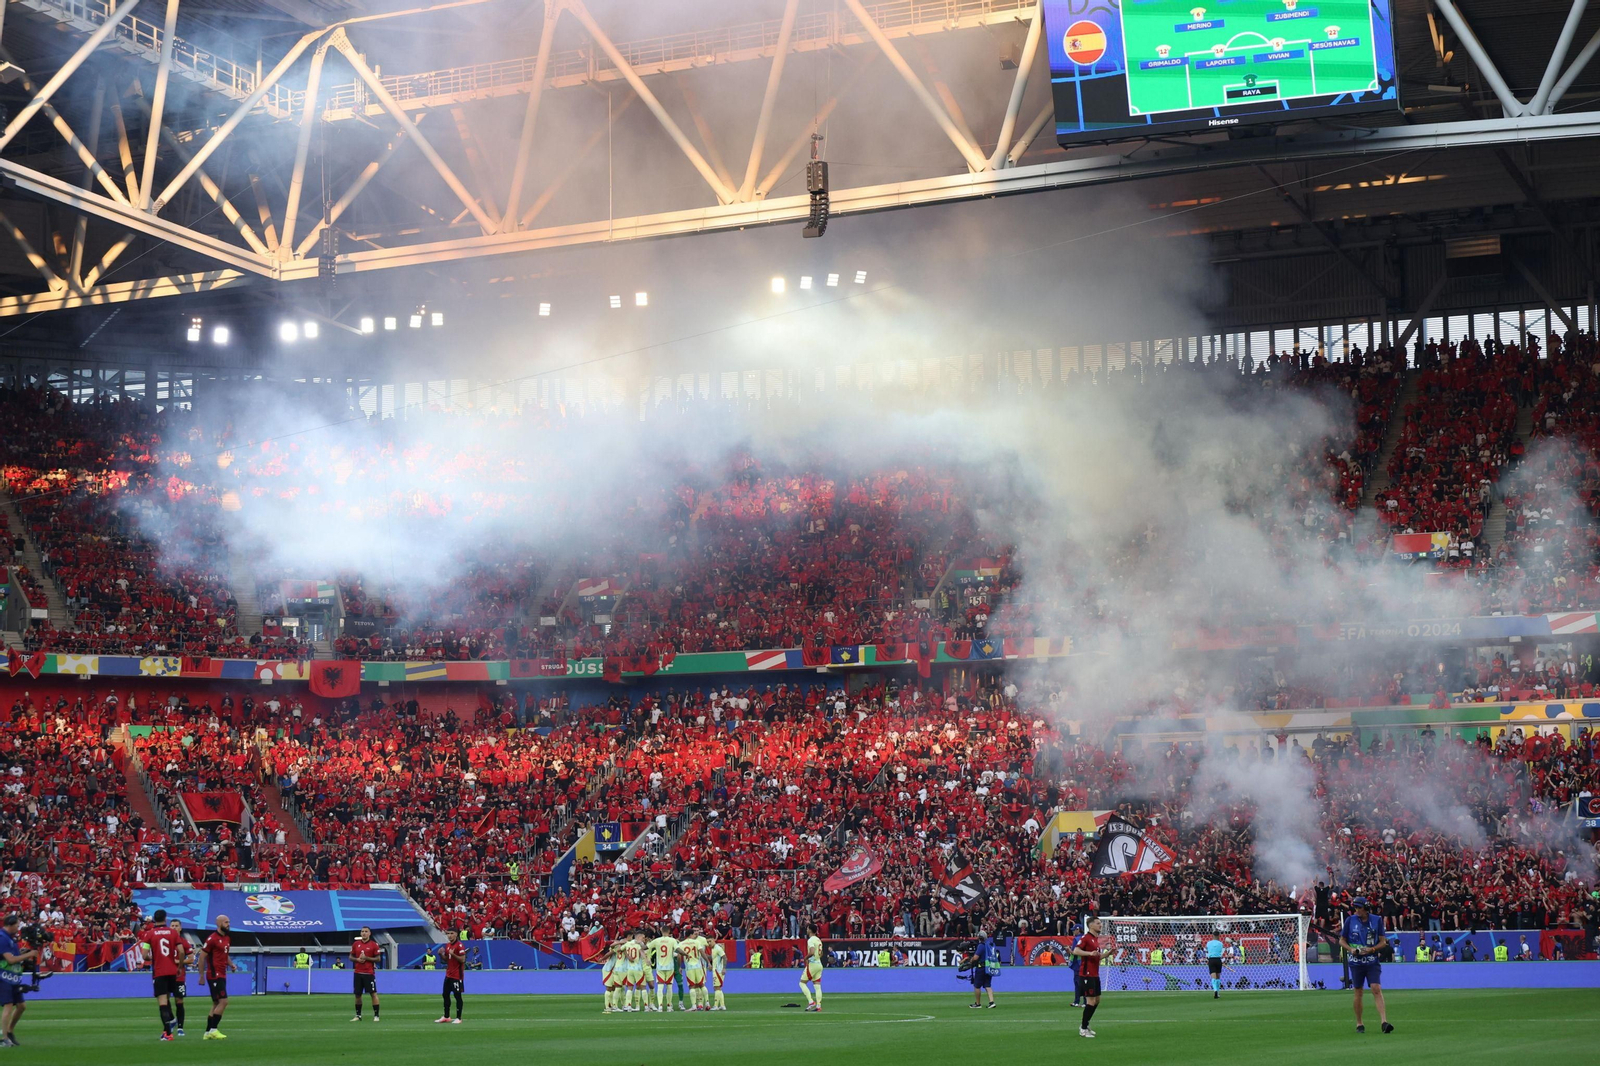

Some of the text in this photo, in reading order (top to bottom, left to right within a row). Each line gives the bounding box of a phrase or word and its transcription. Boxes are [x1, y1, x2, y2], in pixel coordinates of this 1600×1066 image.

[1275, 11, 1310, 20] ZUBIMENDI
[1187, 22, 1211, 30] MERINO
[1148, 59, 1181, 67] GRIMALDO
[1208, 118, 1239, 126] Hisense
[1338, 627, 1365, 640] EFA
[160, 938, 170, 956] 6
[660, 945, 668, 958] 9
[684, 946, 698, 959] 21
[908, 950, 935, 967] KUQ
[939, 950, 946, 966] E
